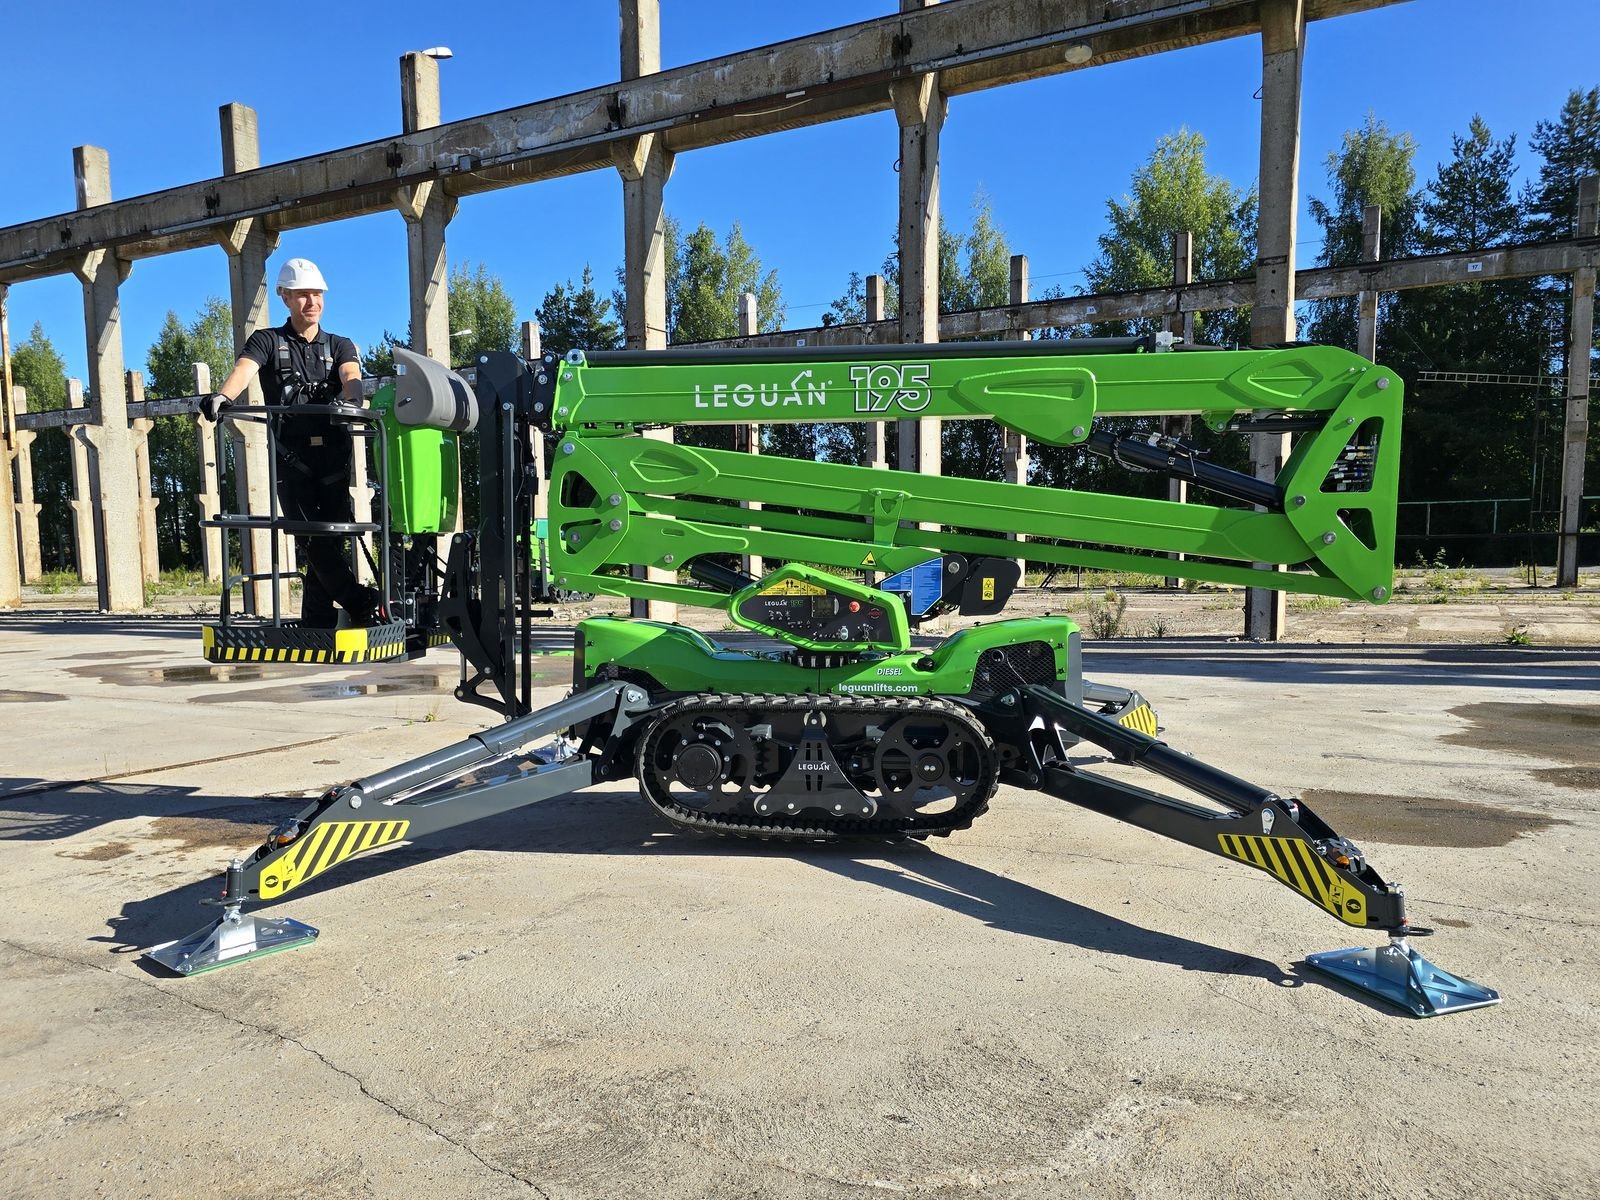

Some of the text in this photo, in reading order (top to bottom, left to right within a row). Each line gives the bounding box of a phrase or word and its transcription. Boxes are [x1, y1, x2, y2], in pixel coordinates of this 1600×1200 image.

[695, 364, 933, 413] LEGUAN 195
[764, 599, 788, 607] LEGUAN
[876, 668, 903, 676] DIESEL
[838, 683, 919, 694] leguanlifts.com
[798, 761, 831, 771] LEGUAN
